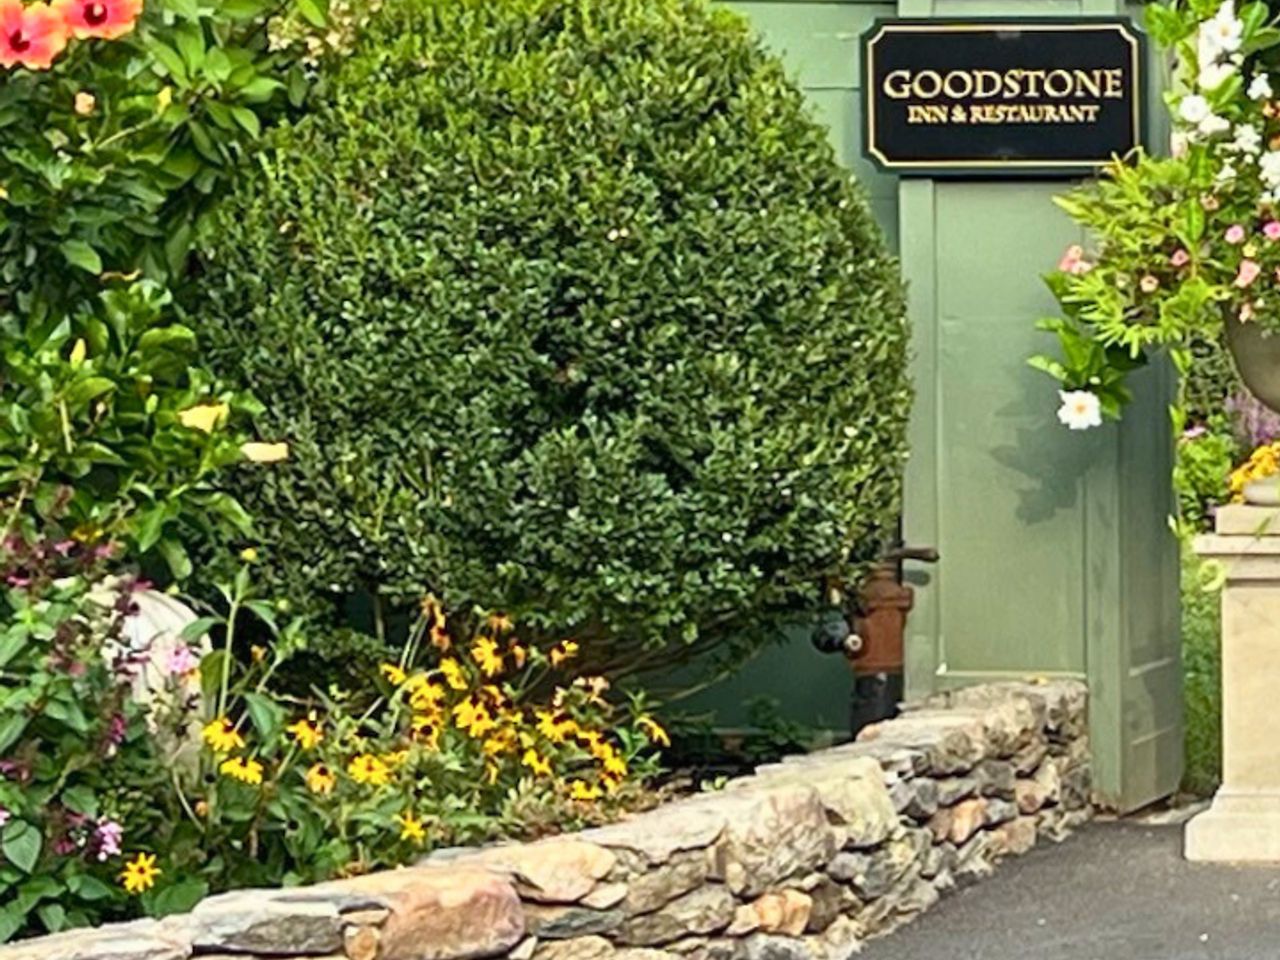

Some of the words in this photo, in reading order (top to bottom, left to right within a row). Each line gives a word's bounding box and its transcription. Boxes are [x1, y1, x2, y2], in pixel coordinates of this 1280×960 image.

[883, 69, 1123, 98] GOODSTONE
[907, 105, 949, 123] INN
[951, 105, 967, 123] &
[970, 105, 1099, 123] RESTAURANT
